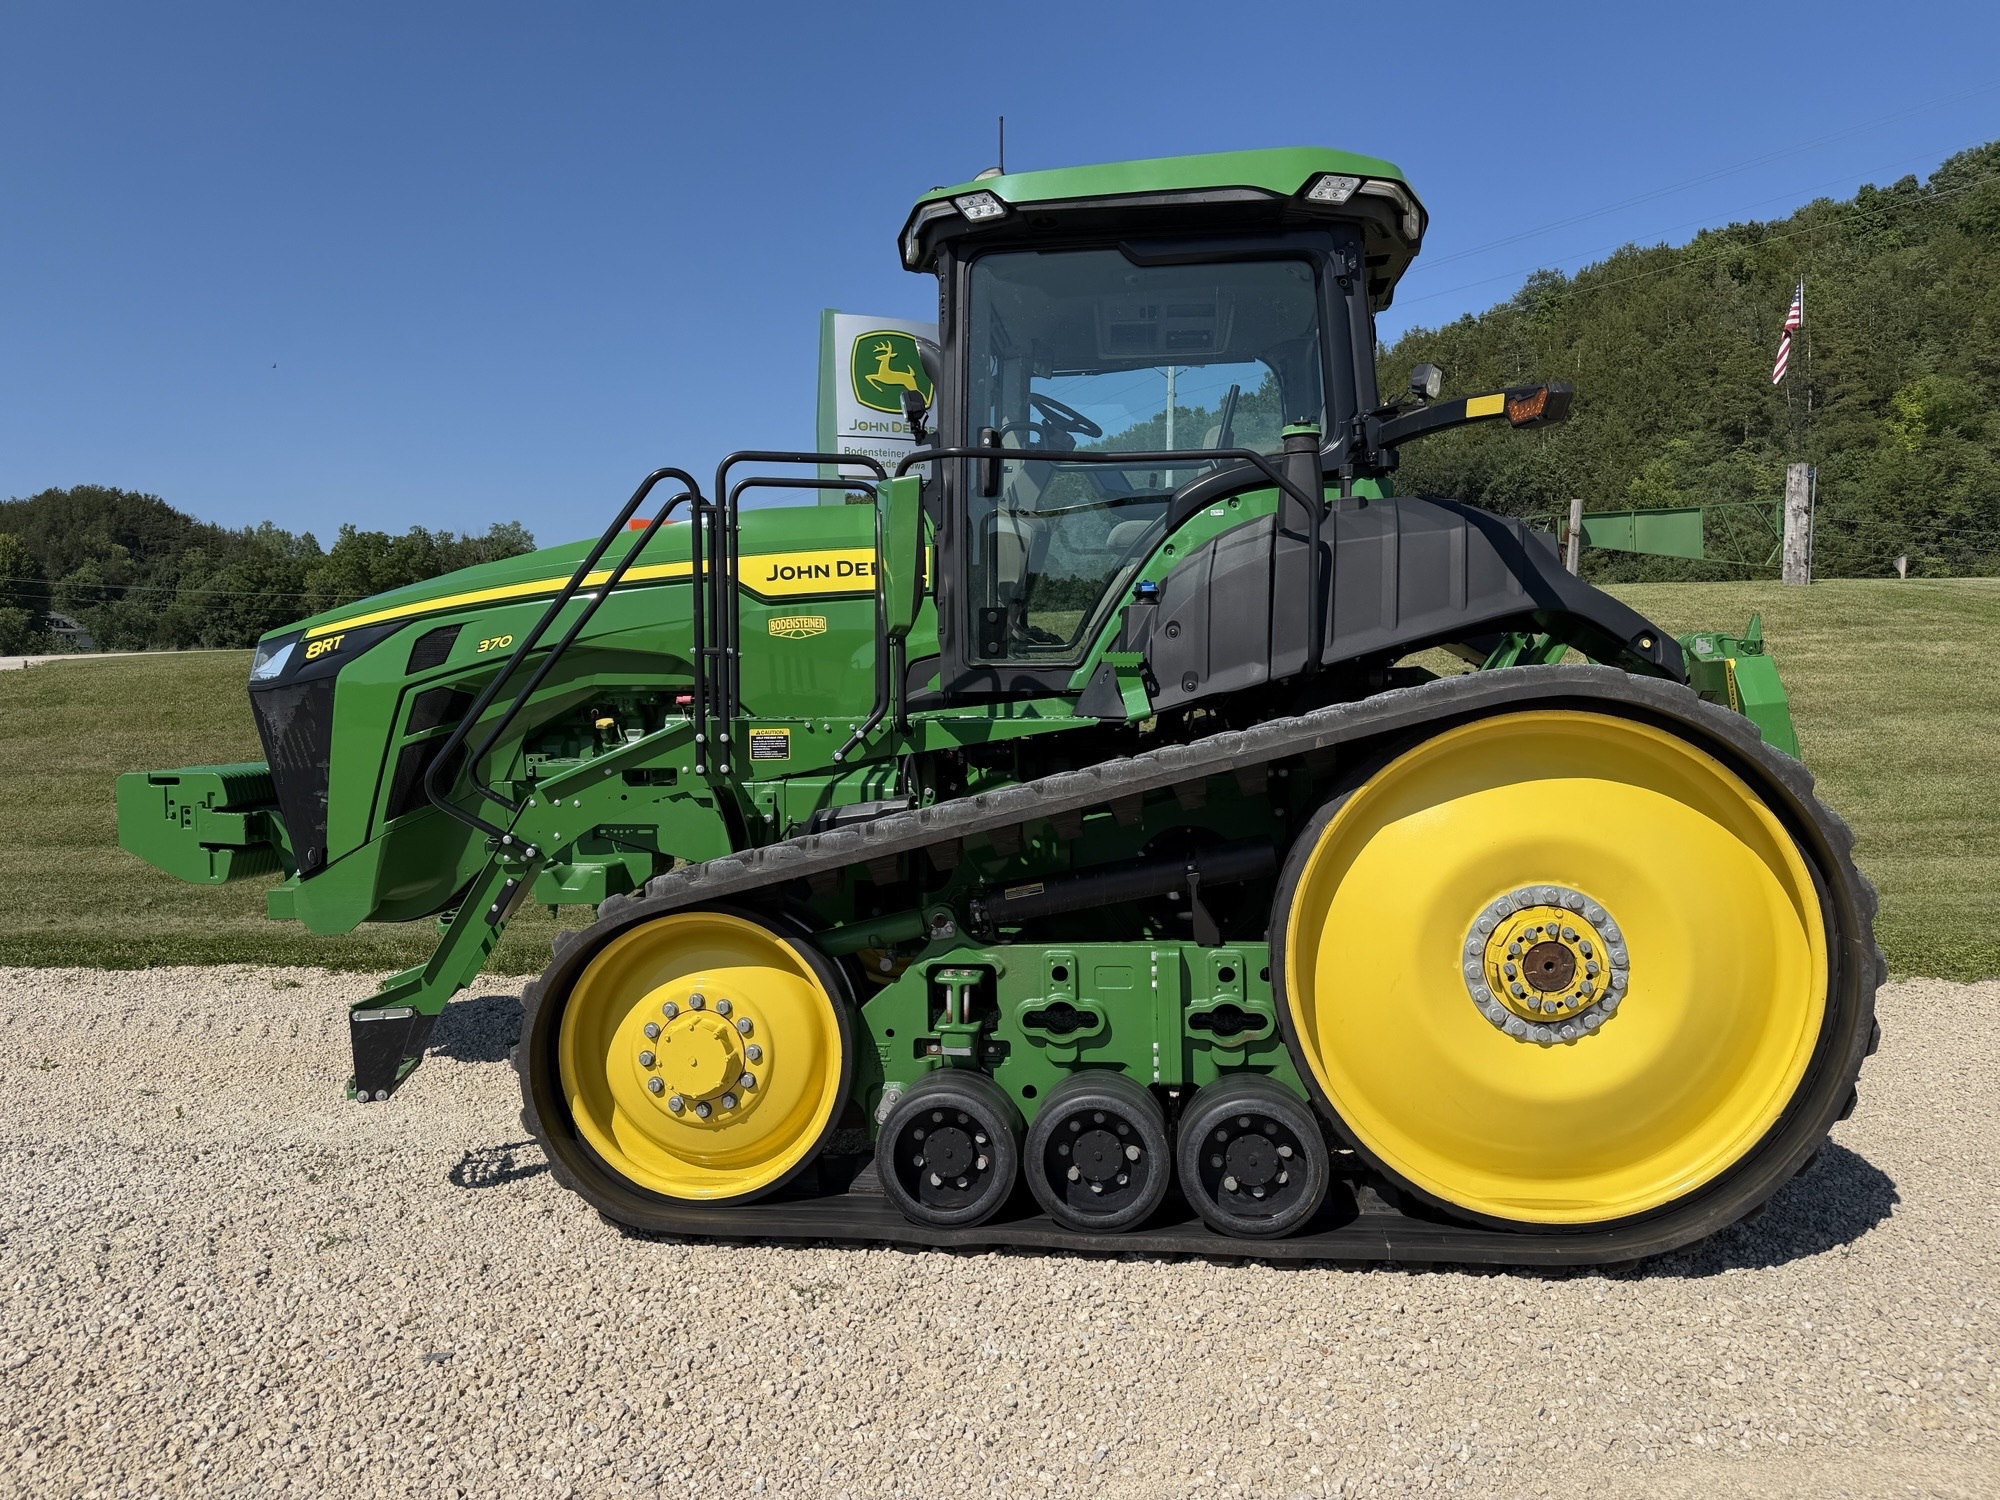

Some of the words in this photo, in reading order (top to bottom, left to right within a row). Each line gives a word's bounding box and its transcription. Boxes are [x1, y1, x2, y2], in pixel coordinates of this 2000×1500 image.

[849, 419, 889, 432] JOHN
[892, 421, 936, 434] DEE
[844, 446, 905, 458] Bodensteiner
[766, 564, 829, 581] JOHN
[770, 617, 825, 631] BODENSTEINER
[305, 634, 345, 659] 8RT
[476, 634, 513, 653] 370
